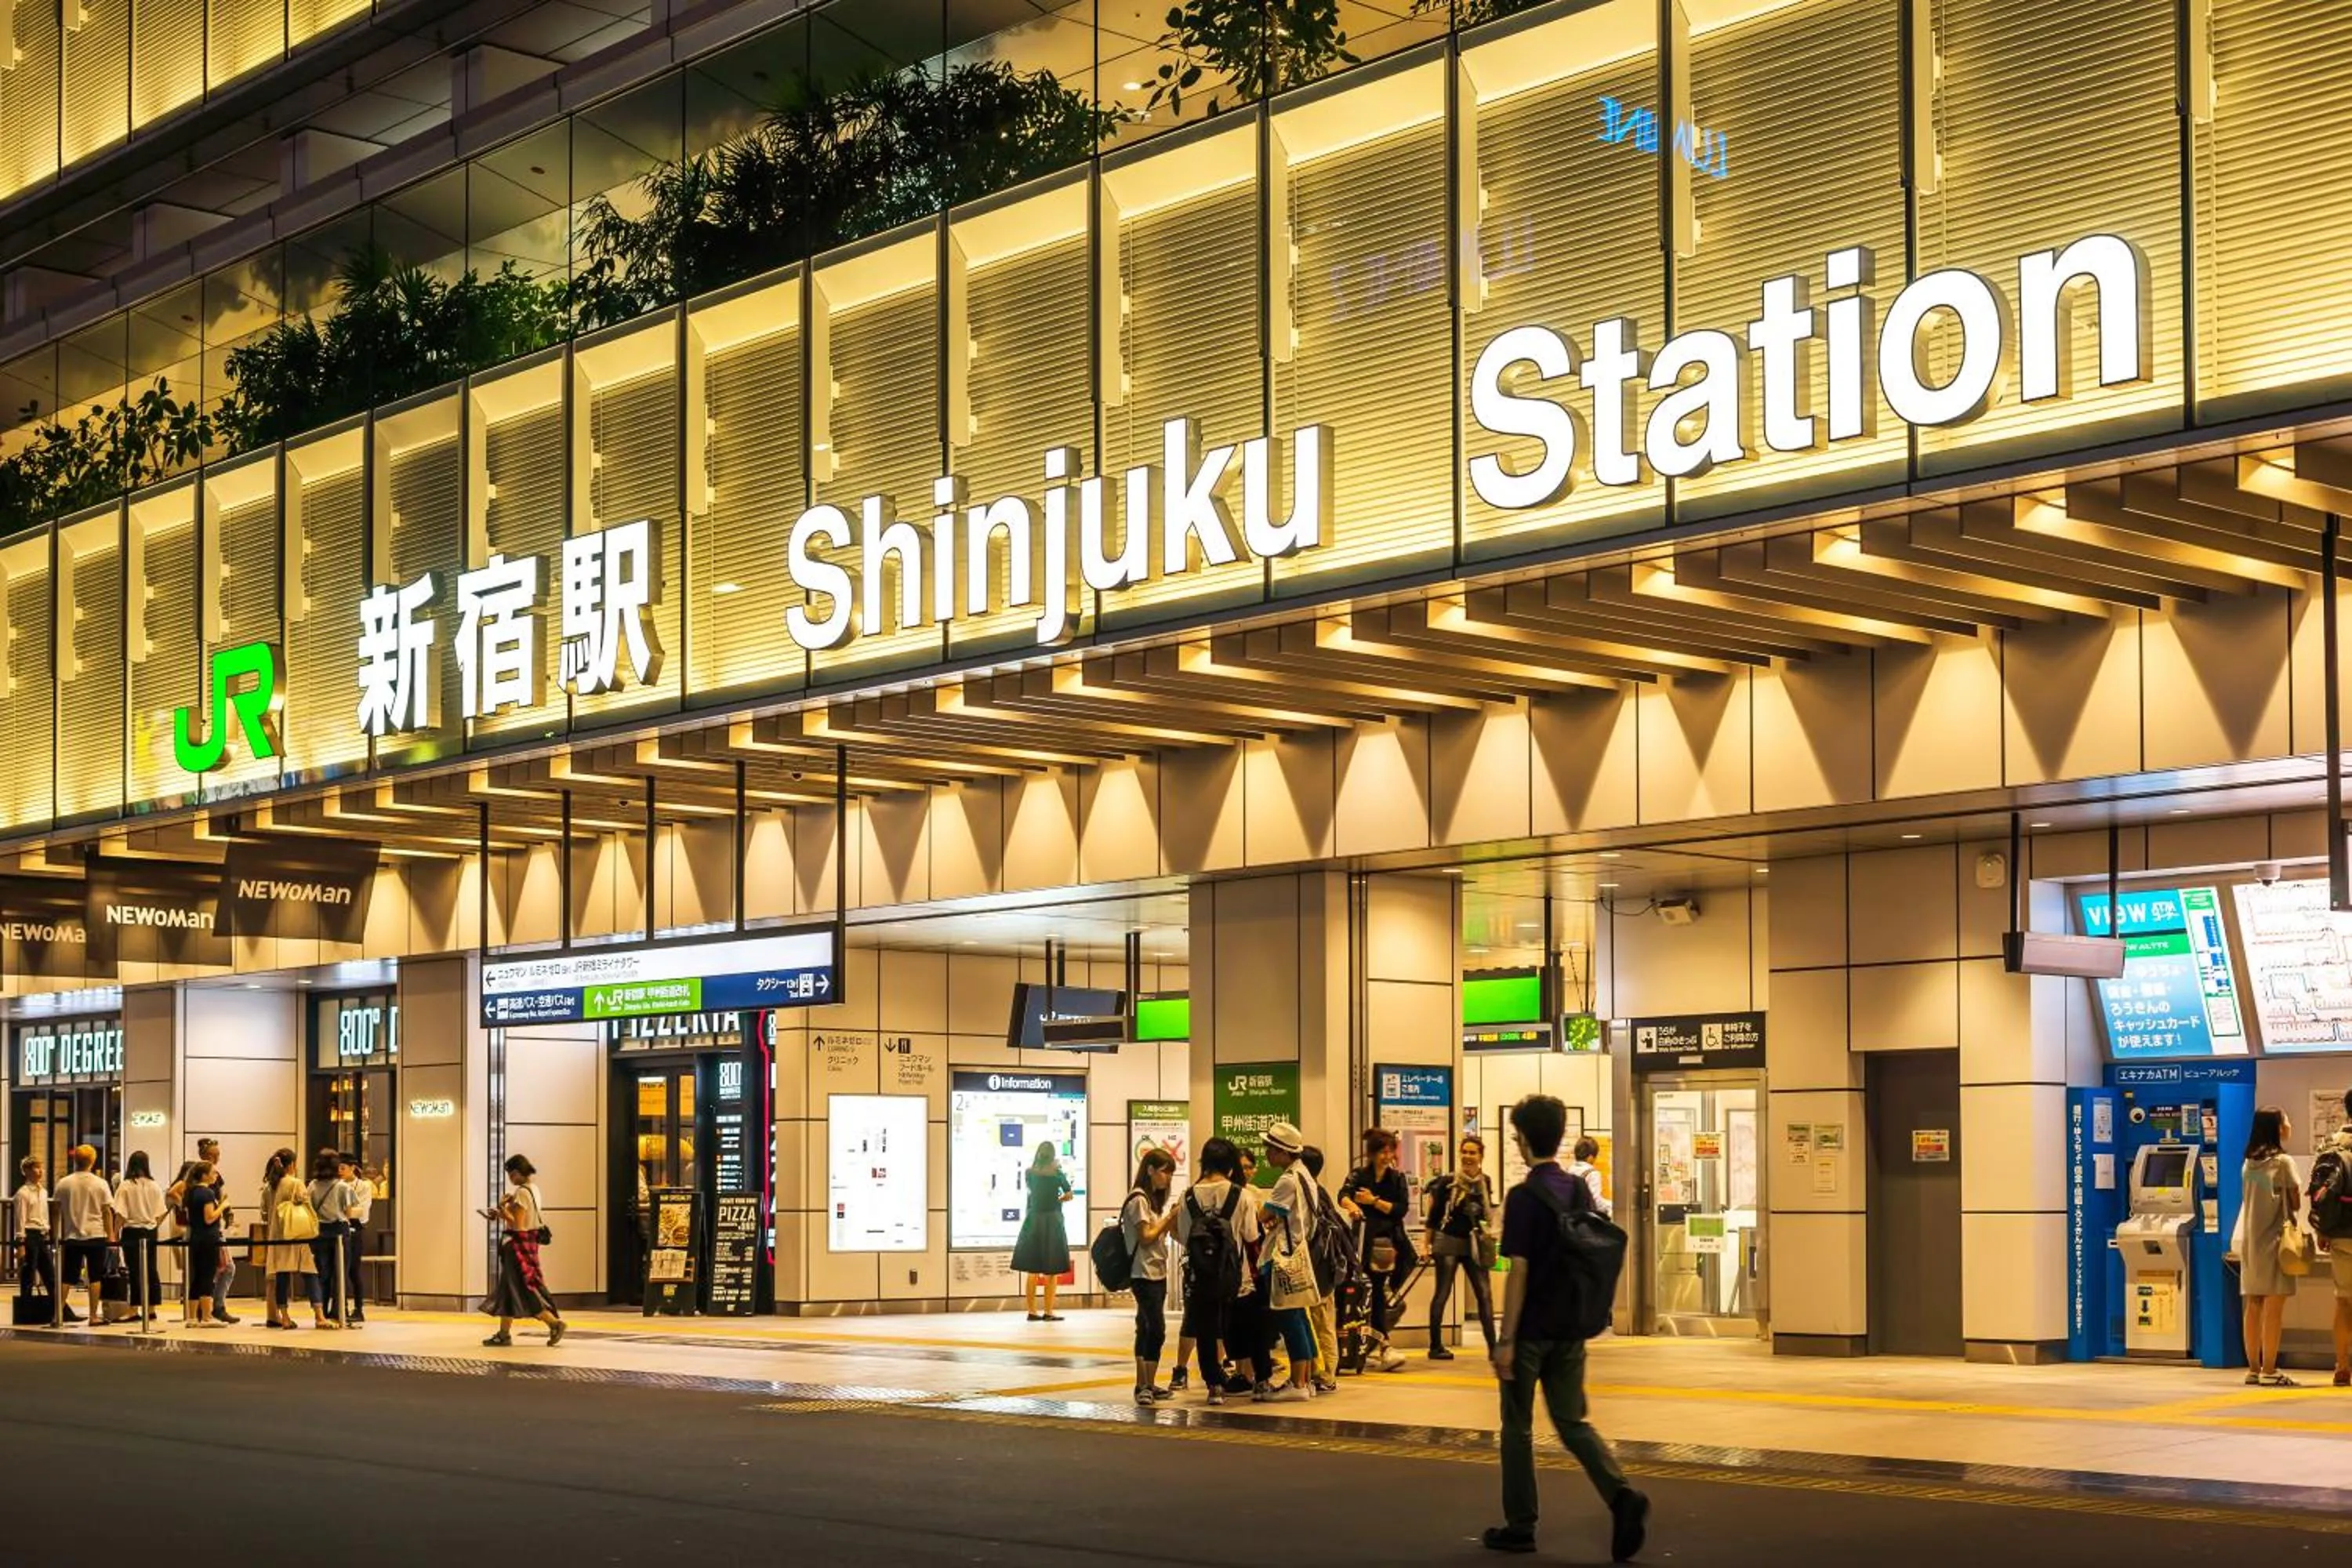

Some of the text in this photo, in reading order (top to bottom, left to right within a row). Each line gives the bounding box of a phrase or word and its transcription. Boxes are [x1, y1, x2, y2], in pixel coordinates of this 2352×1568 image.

[174, 641, 274, 773] JR
[357, 519, 654, 737] 新宿駅
[786, 416, 1323, 651] Shinjuku
[1468, 233, 2142, 511] Station
[607, 989, 623, 1006] JR
[2110, 1000, 2170, 1017] ろうきんの
[2114, 1015, 2201, 1033] キャッシュカード
[2120, 1068, 2241, 1080] エキナカATM ビューアルッテ
[1002, 1076, 1052, 1090] Information
[1229, 1075, 1247, 1091] JR
[718, 1206, 757, 1222] PIZZA
